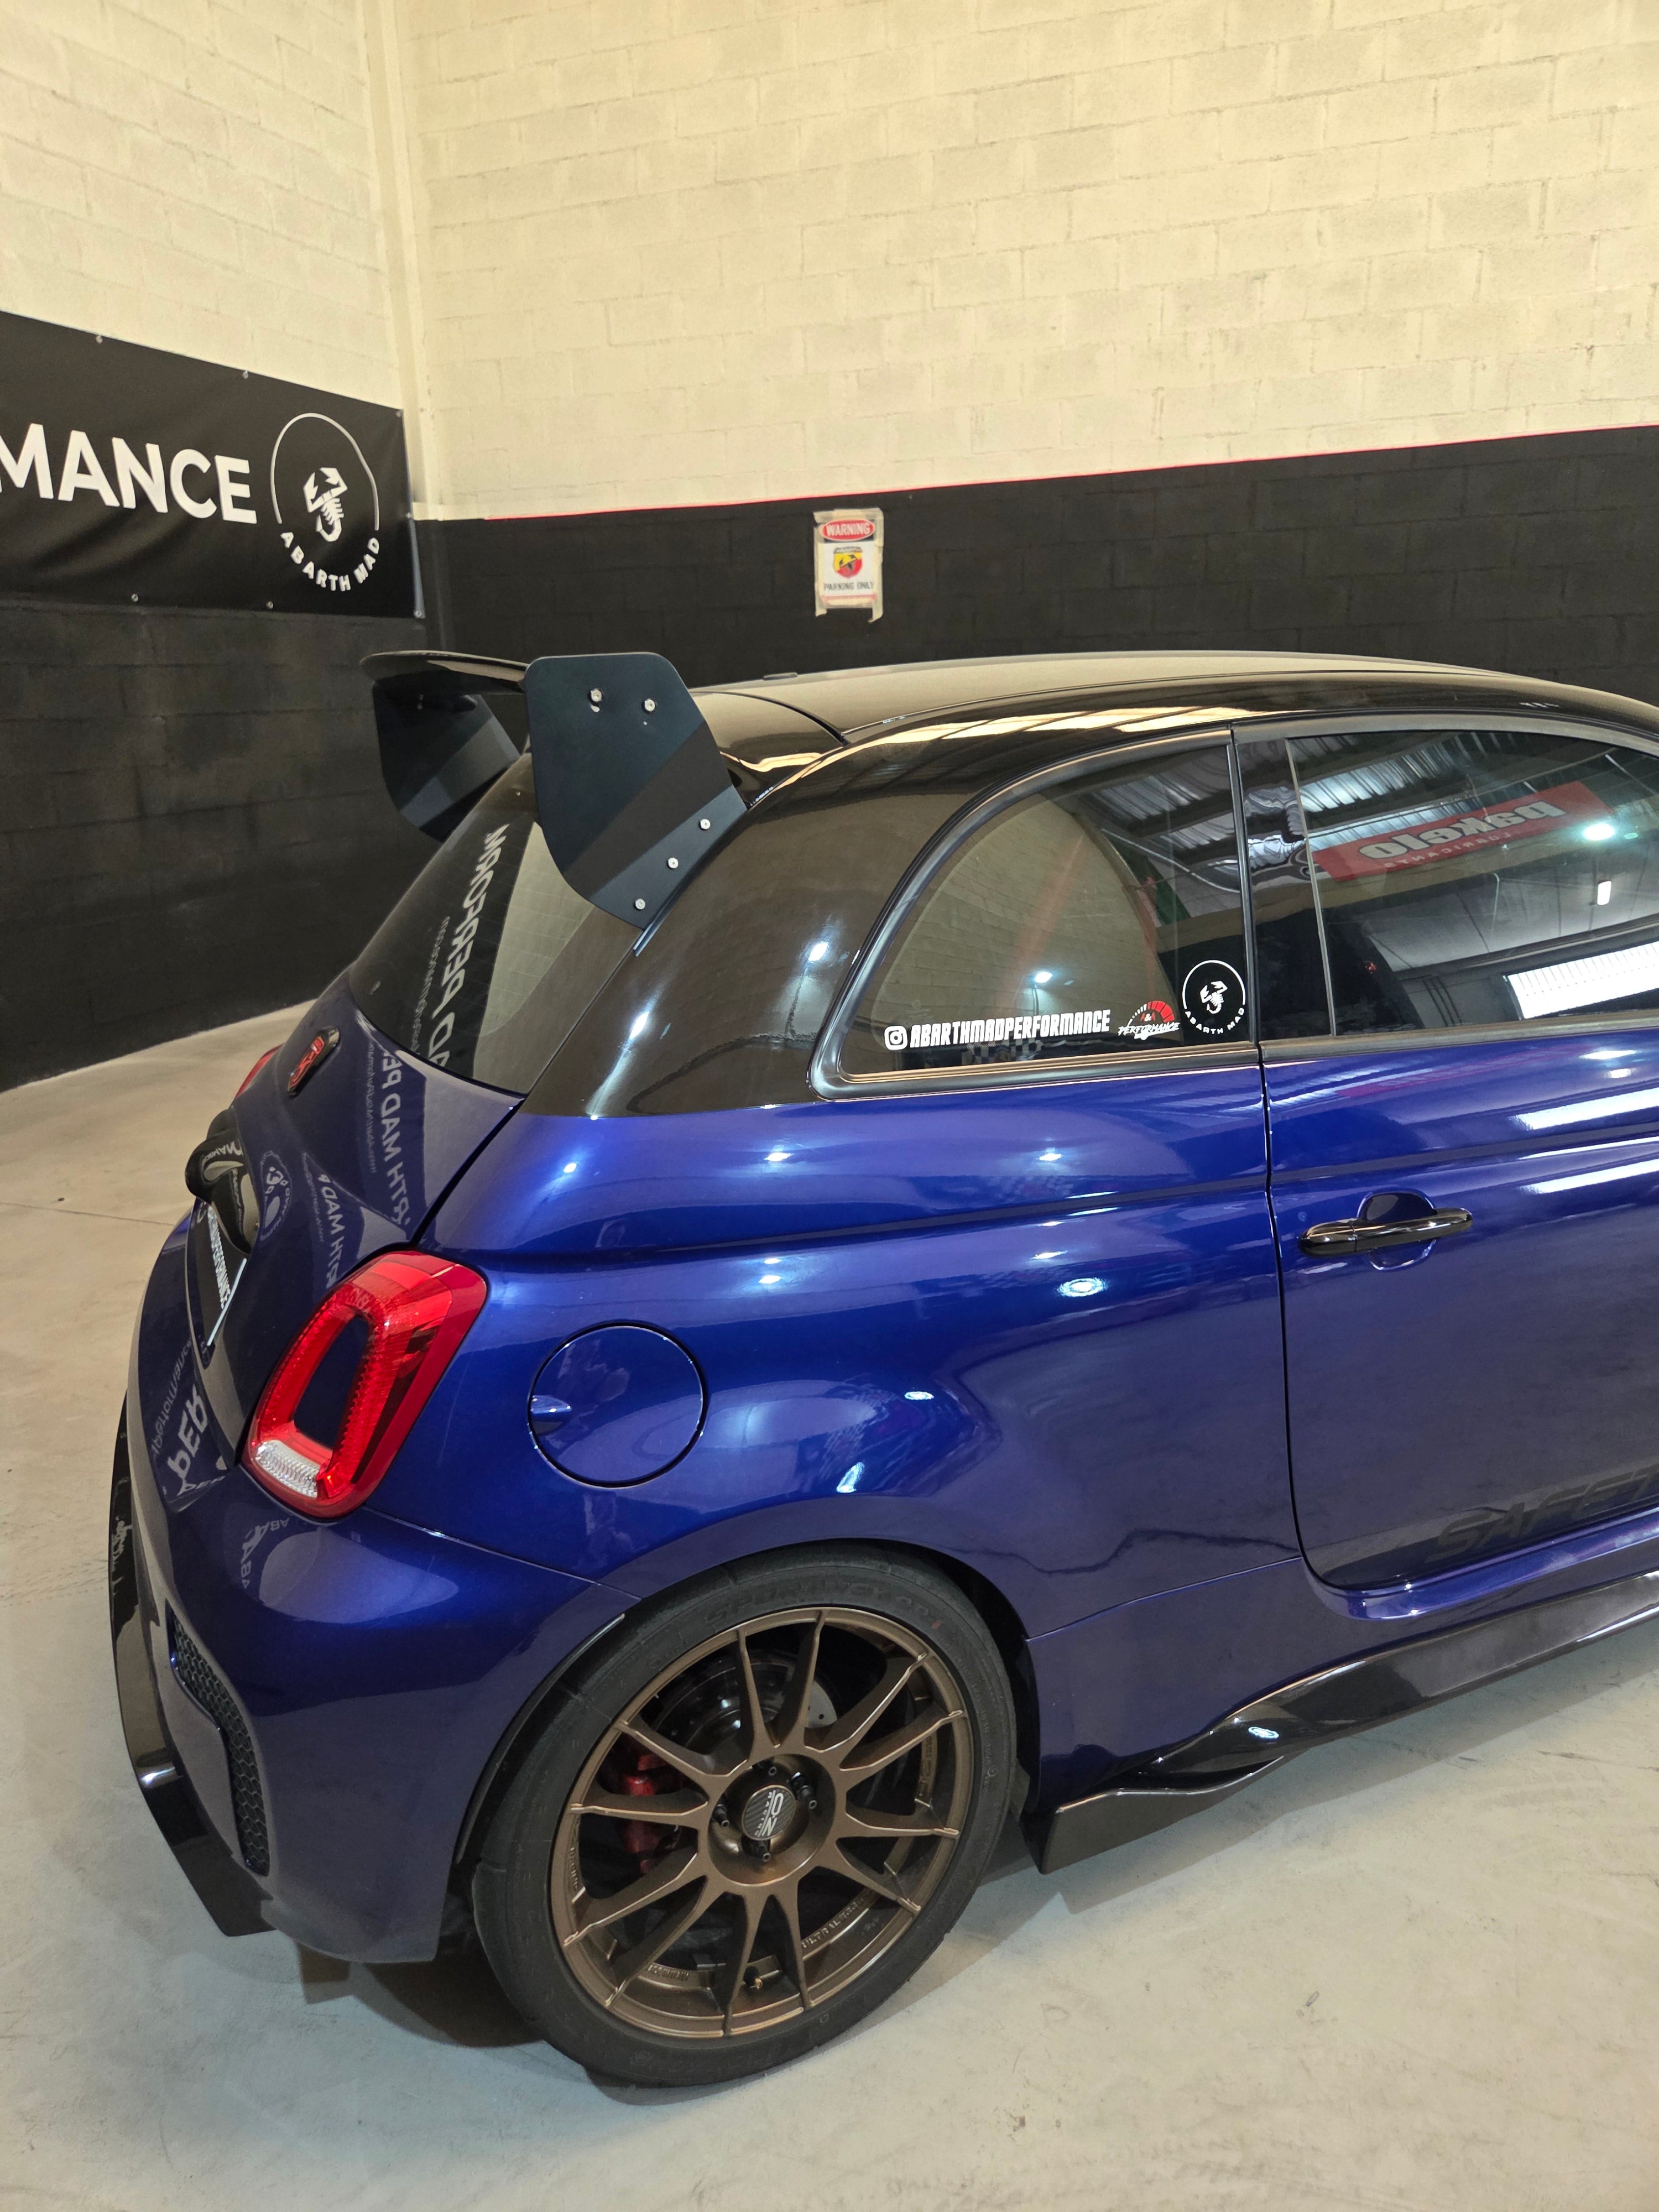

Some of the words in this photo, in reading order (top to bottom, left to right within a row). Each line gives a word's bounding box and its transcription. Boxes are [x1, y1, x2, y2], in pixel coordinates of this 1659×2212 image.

[0, 423, 257, 524] MANCE
[826, 522, 870, 536] WARNING
[280, 531, 351, 592] ABARTH
[353, 537, 380, 584] MAD
[823, 582, 854, 591] PARKING
[857, 581, 873, 590] ONLY
[1140, 1012, 1156, 1022] A&A
[1185, 1010, 1224, 1035] ABARTH
[1227, 1008, 1244, 1030] MAD
[910, 1009, 1111, 1048] ABARTHMADPERFORMANCE
[1118, 1021, 1180, 1037] PERFORMANCE
